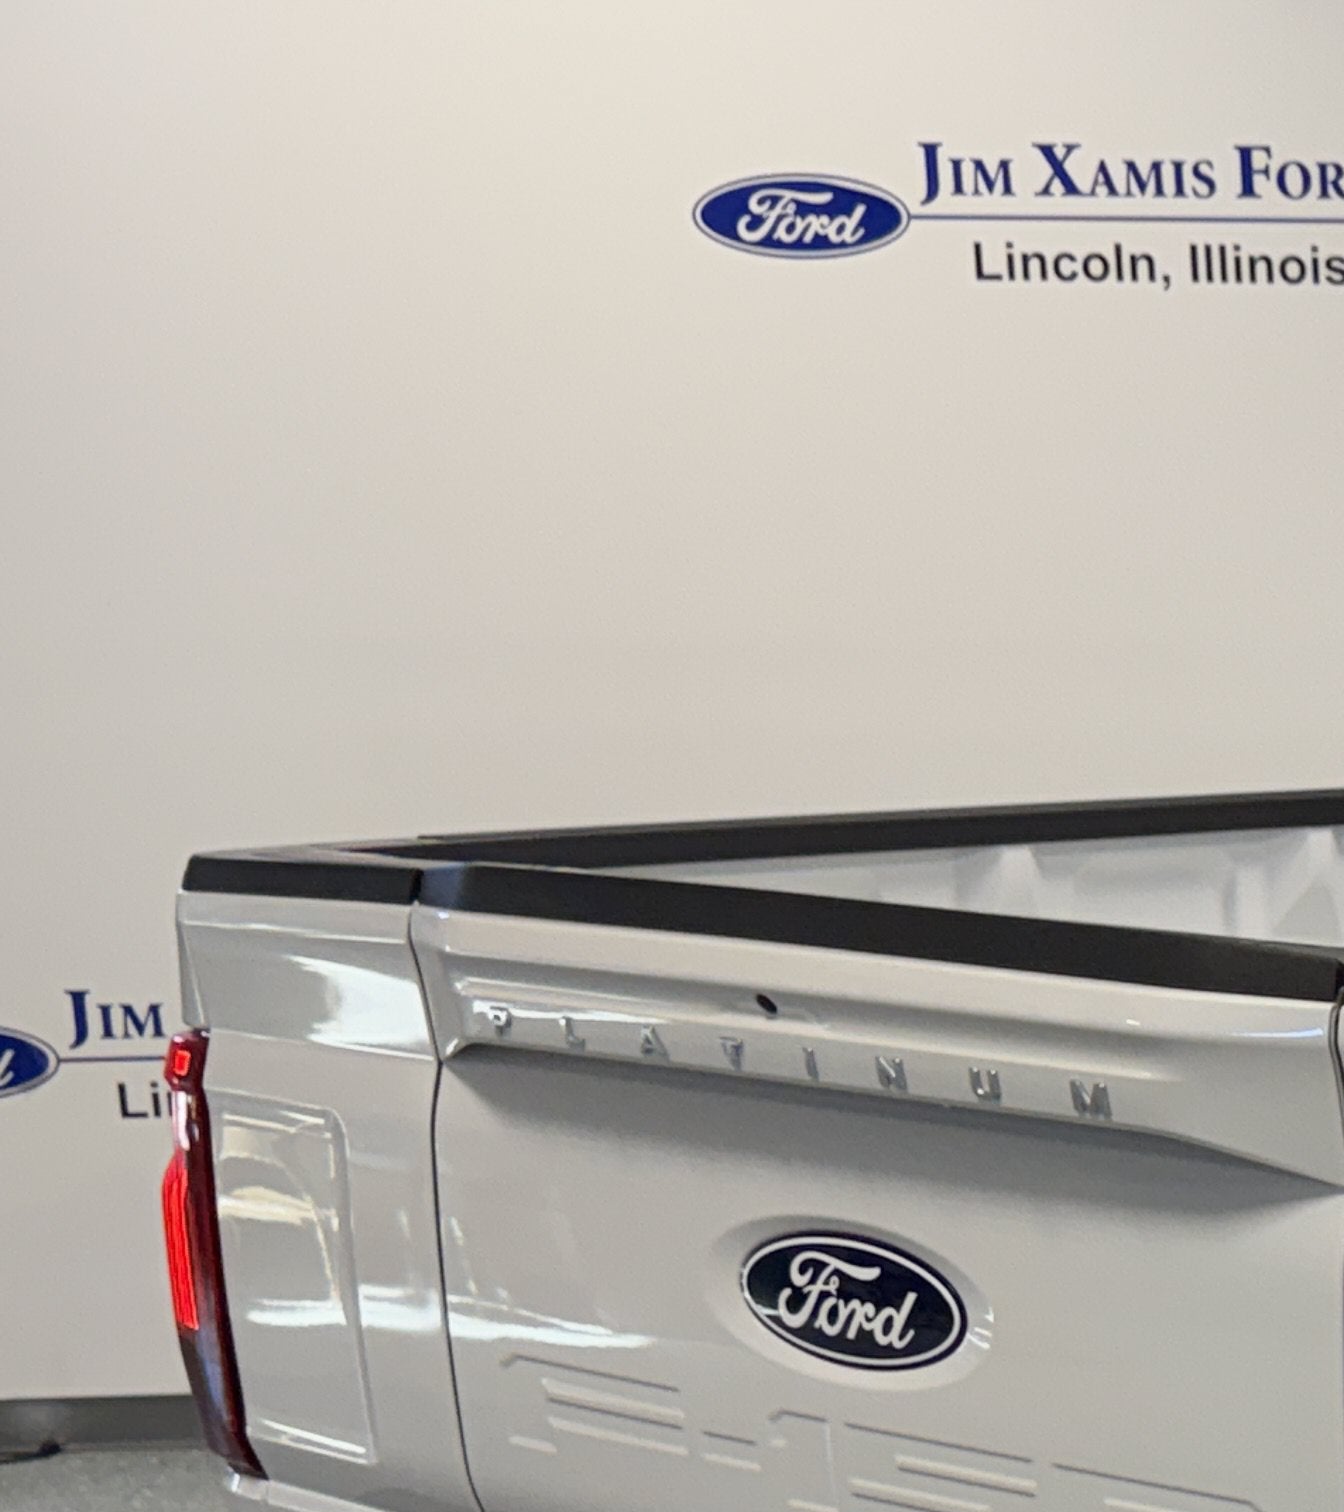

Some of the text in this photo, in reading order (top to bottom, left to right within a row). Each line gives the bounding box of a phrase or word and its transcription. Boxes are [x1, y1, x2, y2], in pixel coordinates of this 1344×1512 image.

[919, 141, 1013, 206] JIM
[1031, 143, 1217, 200] XAMIS
[735, 187, 866, 246] Ford
[974, 242, 1172, 291] Lincoln,
[64, 989, 167, 1049] JIM
[487, 1004, 1113, 1120] PLATINUM
[776, 1249, 919, 1350] Ford
